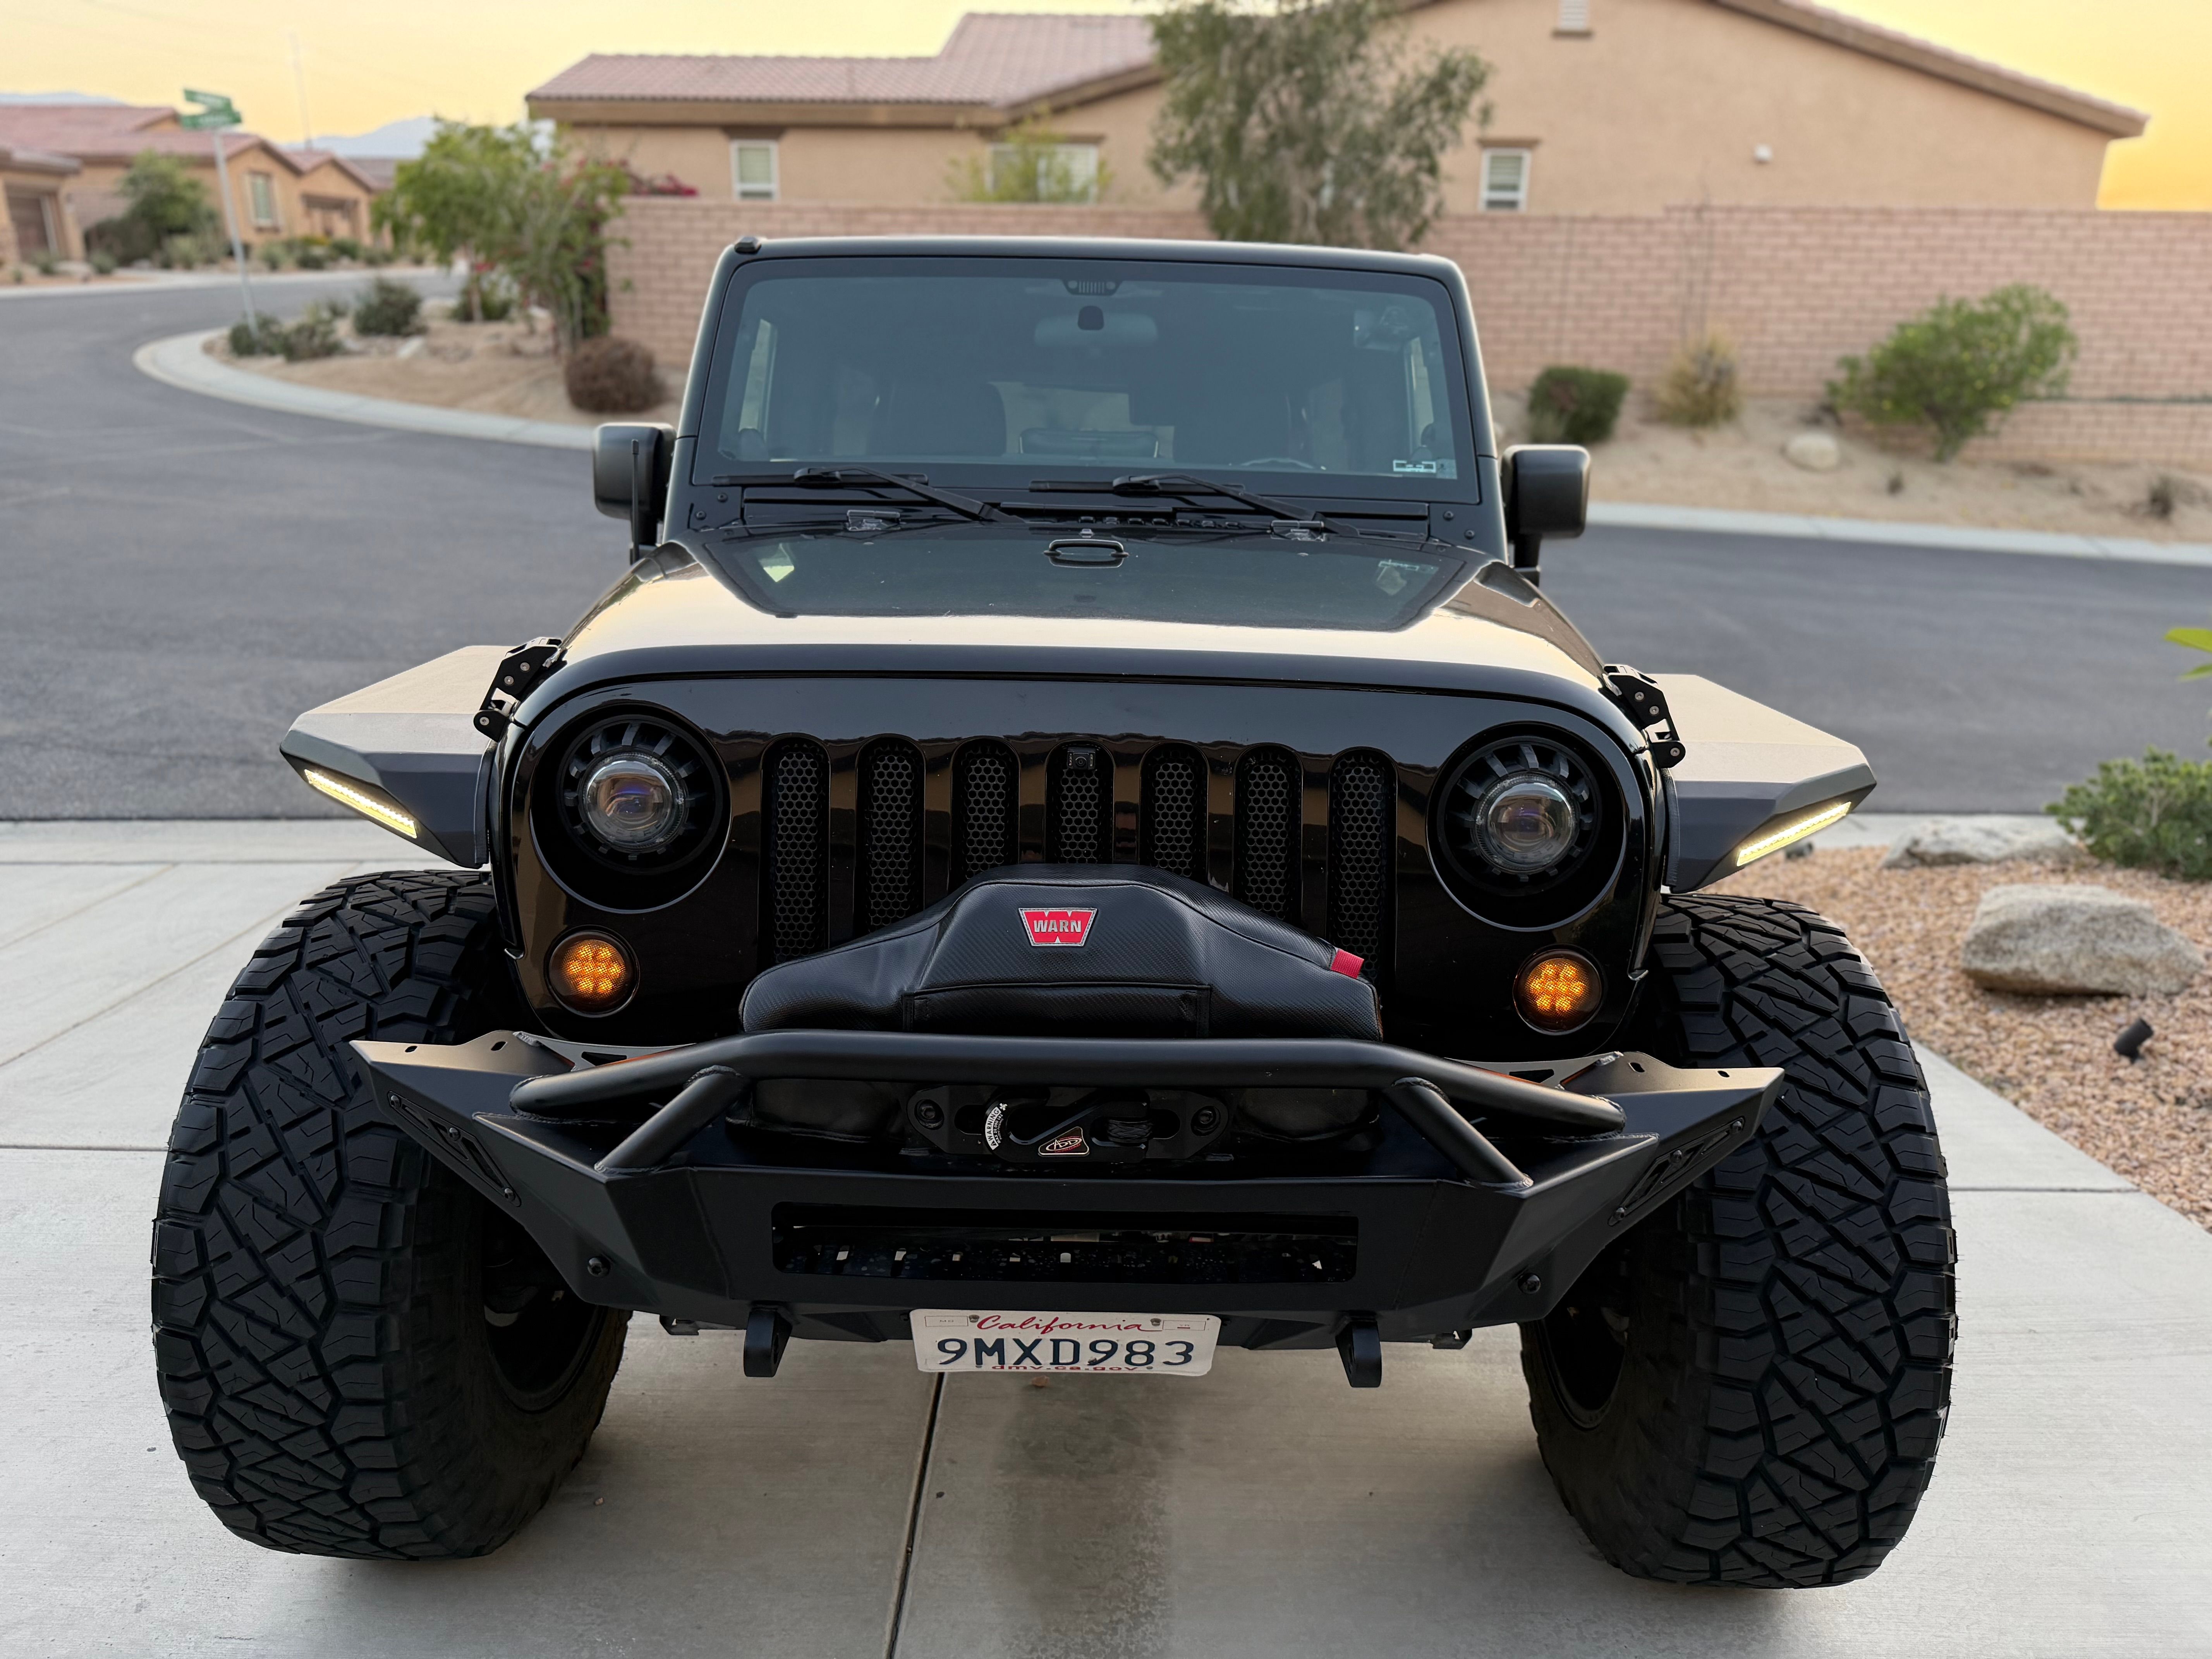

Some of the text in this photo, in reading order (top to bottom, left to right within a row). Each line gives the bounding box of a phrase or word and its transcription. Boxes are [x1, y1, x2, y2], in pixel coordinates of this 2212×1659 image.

[1034, 920, 1081, 933] WARN
[987, 1109, 999, 1141] WARNING
[977, 1315, 1162, 1334] California
[938, 1338, 1194, 1366] 9MXD983
